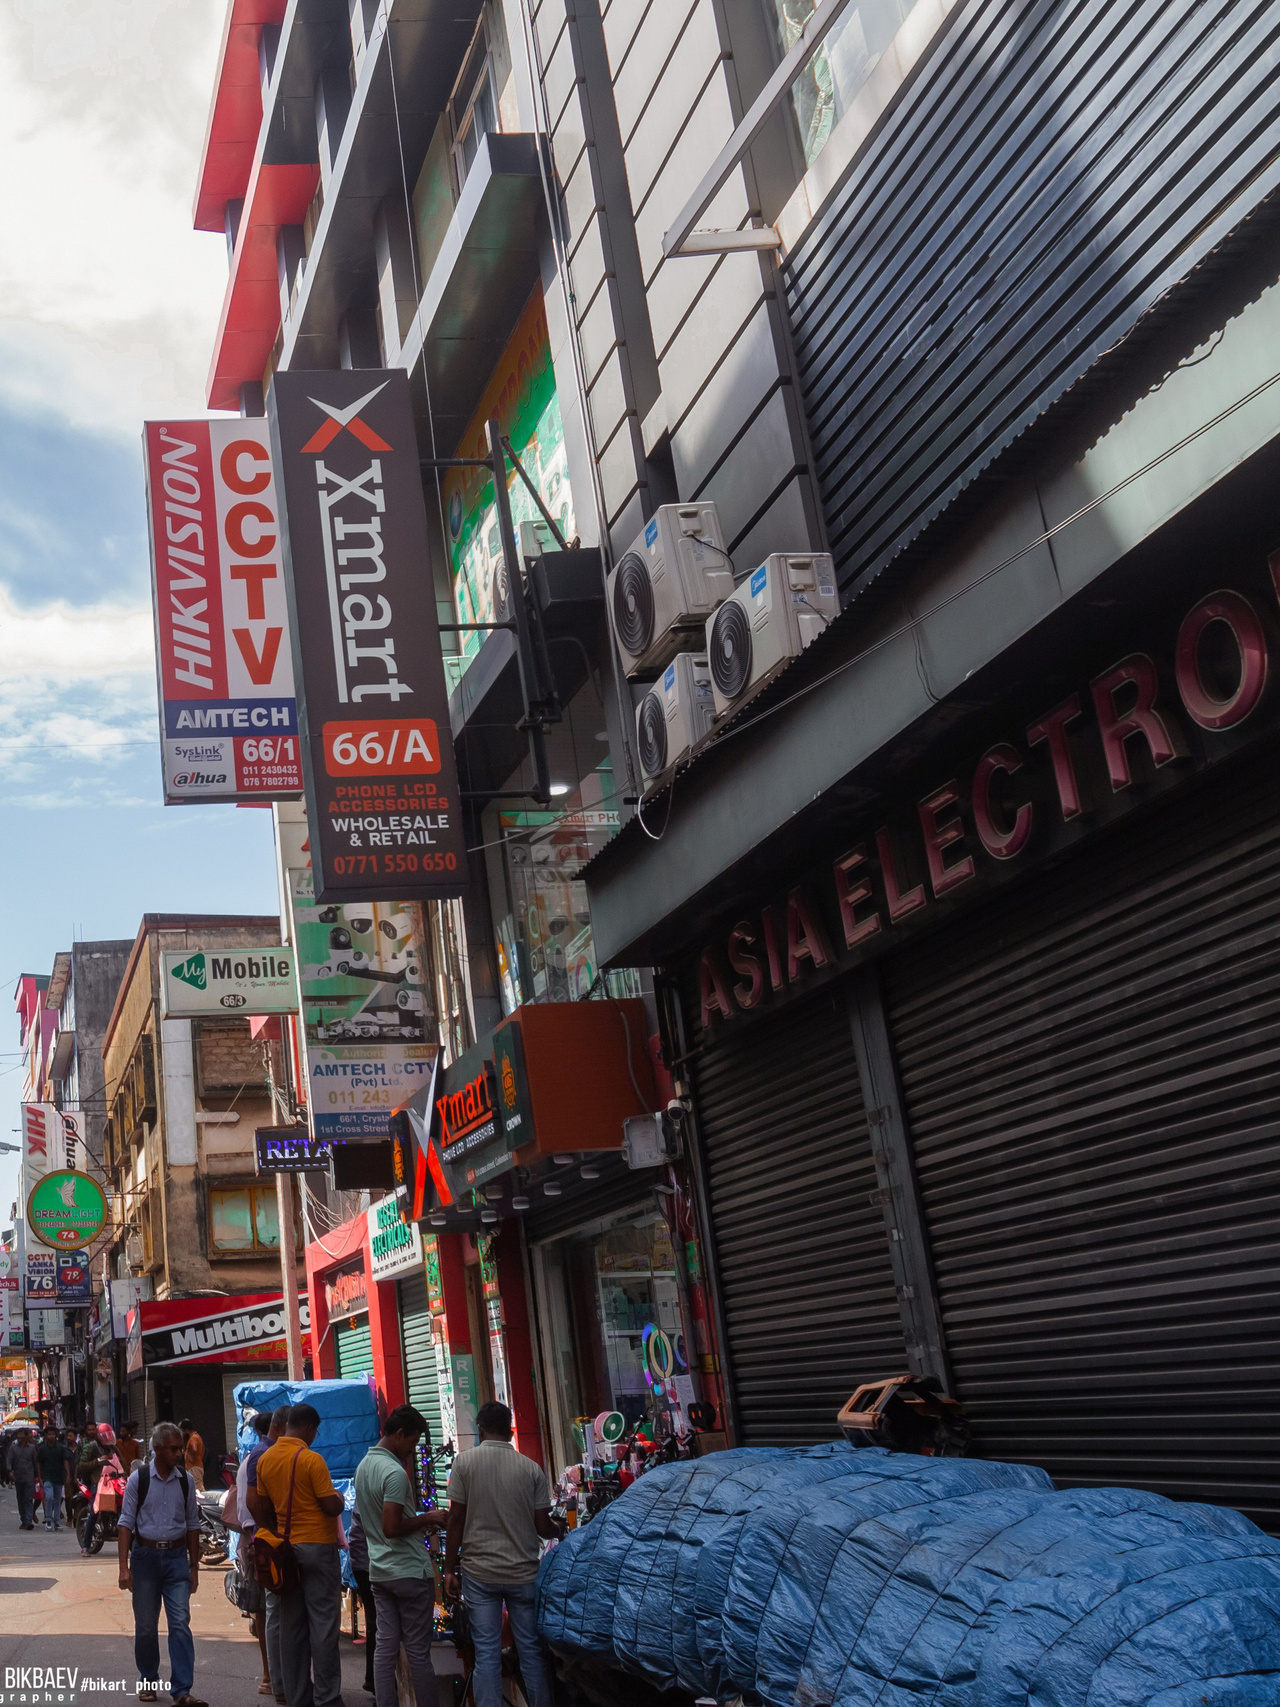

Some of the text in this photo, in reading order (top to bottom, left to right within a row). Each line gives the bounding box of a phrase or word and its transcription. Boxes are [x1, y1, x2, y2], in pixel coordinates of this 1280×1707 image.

[160, 434, 214, 691] HIKVISION
[220, 439, 283, 686] CCTV
[176, 707, 290, 729] AMTECH
[175, 744, 220, 758] SysLink
[242, 737, 295, 763] 66/1
[332, 729, 434, 765] 66/A
[243, 765, 297, 775] 011 2430432
[244, 777, 299, 786] 076 7802799
[699, 548, 1280, 1031] ASIA ELECTRO
[336, 783, 437, 799] PHONE LCD
[328, 797, 449, 813] ACCESSORIES
[332, 815, 449, 832] WHOLESALE
[350, 831, 437, 847] & RETAIL
[334, 852, 457, 875] 0771 550 650
[211, 956, 290, 980] Mobile
[223, 996, 243, 1006] 66/3
[313, 1063, 386, 1077] AMTECH
[351, 1077, 378, 1089] (Pvt)
[328, 1091, 355, 1105] 011
[321, 1124, 389, 1134] 1st Cross Street
[466, 1122, 495, 1149] ACCESSORIES
[266, 1140, 346, 1159] RETA
[61, 1231, 75, 1239] 74
[372, 1223, 411, 1258] ELECTRICALS
[27, 1253, 55, 1261] CCTV
[30, 1276, 53, 1289] 76
[9, 1333, 23, 1342] 96
[171, 1304, 311, 1356] Multibod
